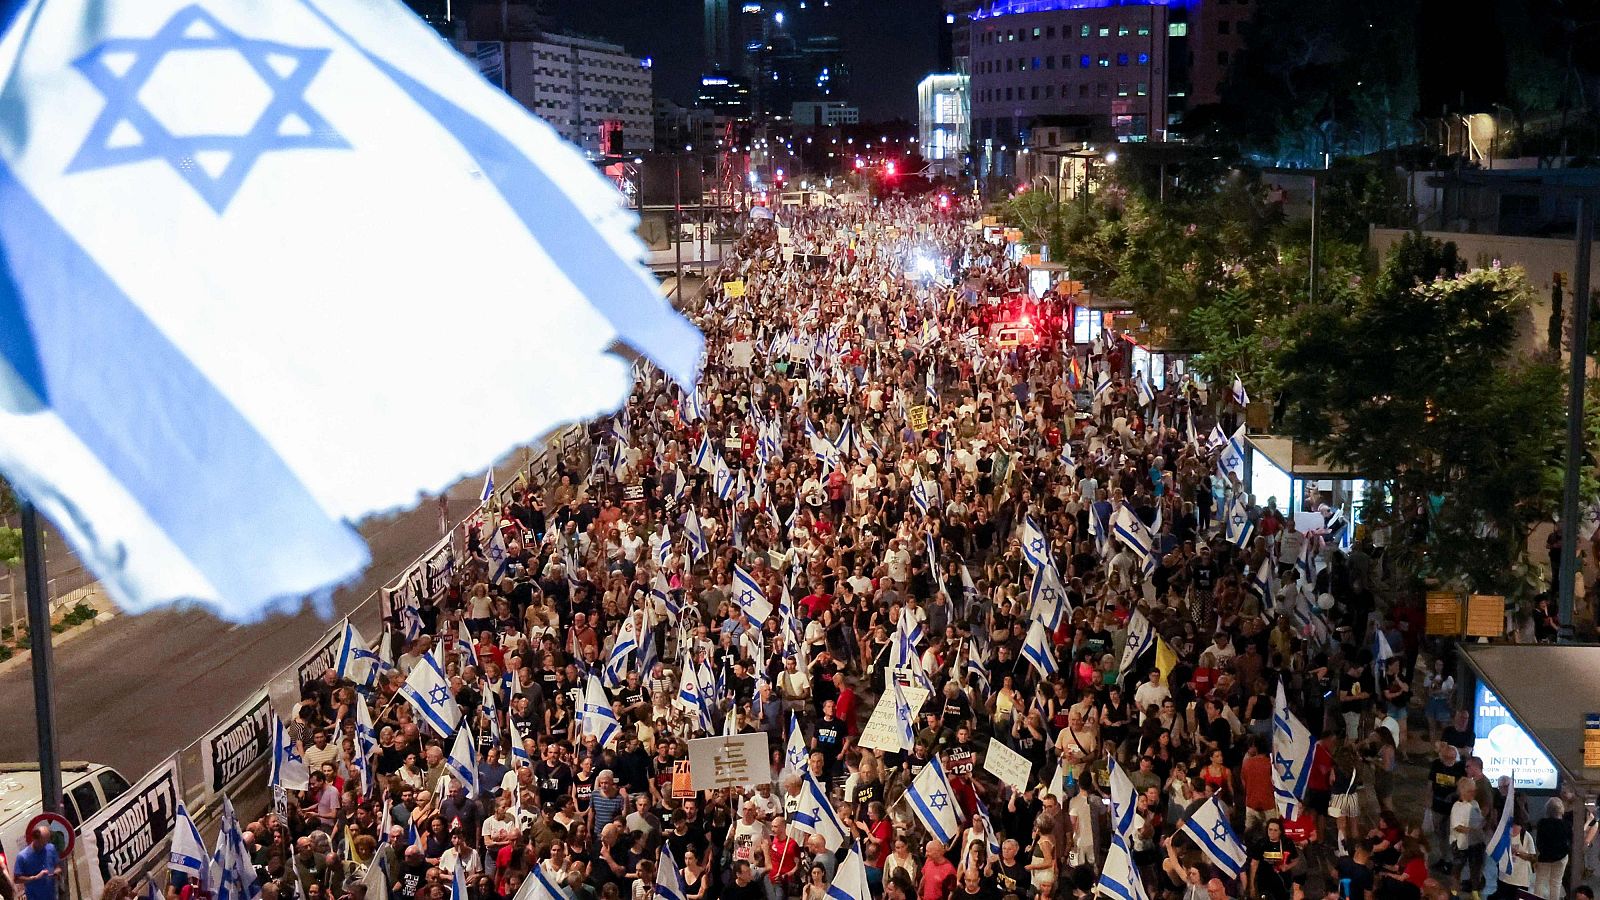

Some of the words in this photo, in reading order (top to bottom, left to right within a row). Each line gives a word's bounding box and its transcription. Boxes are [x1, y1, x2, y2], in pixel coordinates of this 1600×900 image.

[216, 714, 256, 763] לממשלת
[949, 751, 971, 761] עסקה
[953, 747, 963, 755] רק
[1490, 757, 1537, 765] INFINITY
[952, 763, 973, 774] 120
[102, 795, 148, 855] לממשלת
